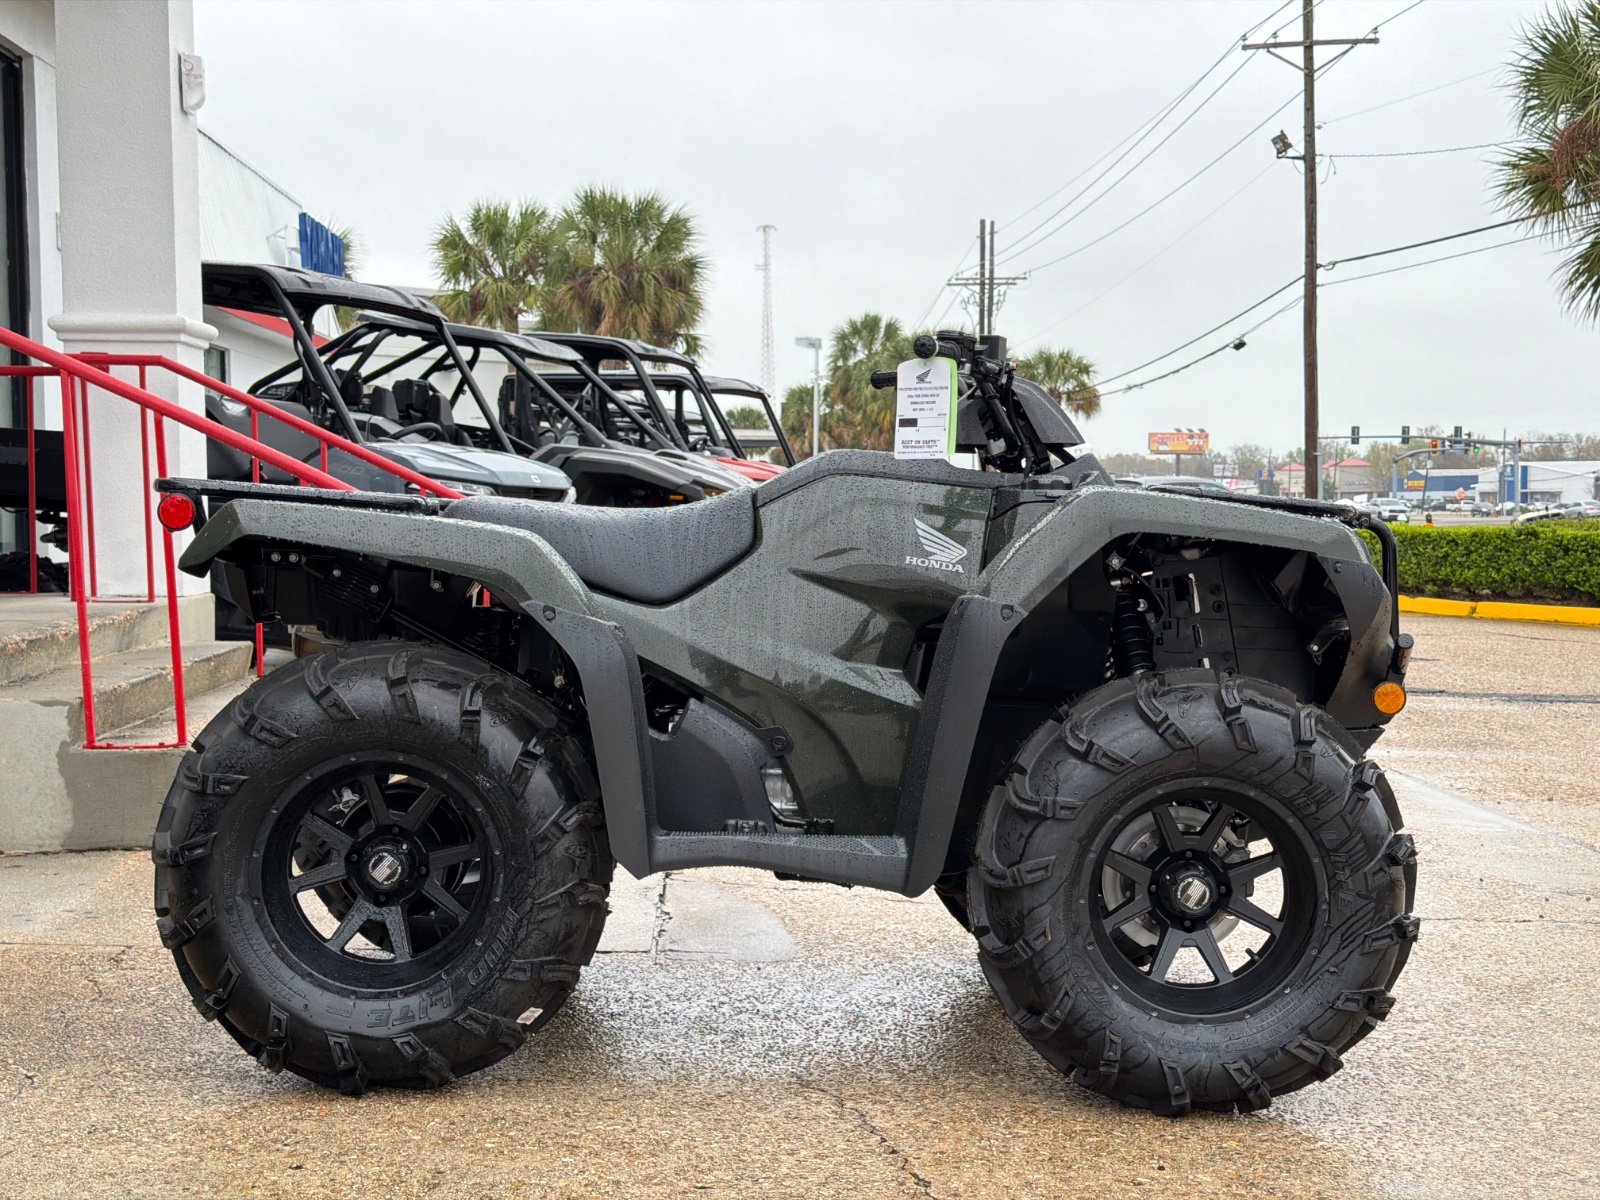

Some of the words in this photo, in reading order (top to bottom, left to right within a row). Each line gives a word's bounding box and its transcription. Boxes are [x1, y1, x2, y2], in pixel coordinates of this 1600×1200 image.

[904, 556, 964, 573] HONDA
[464, 905, 522, 986] MUD
[367, 985, 457, 1028] LITE
